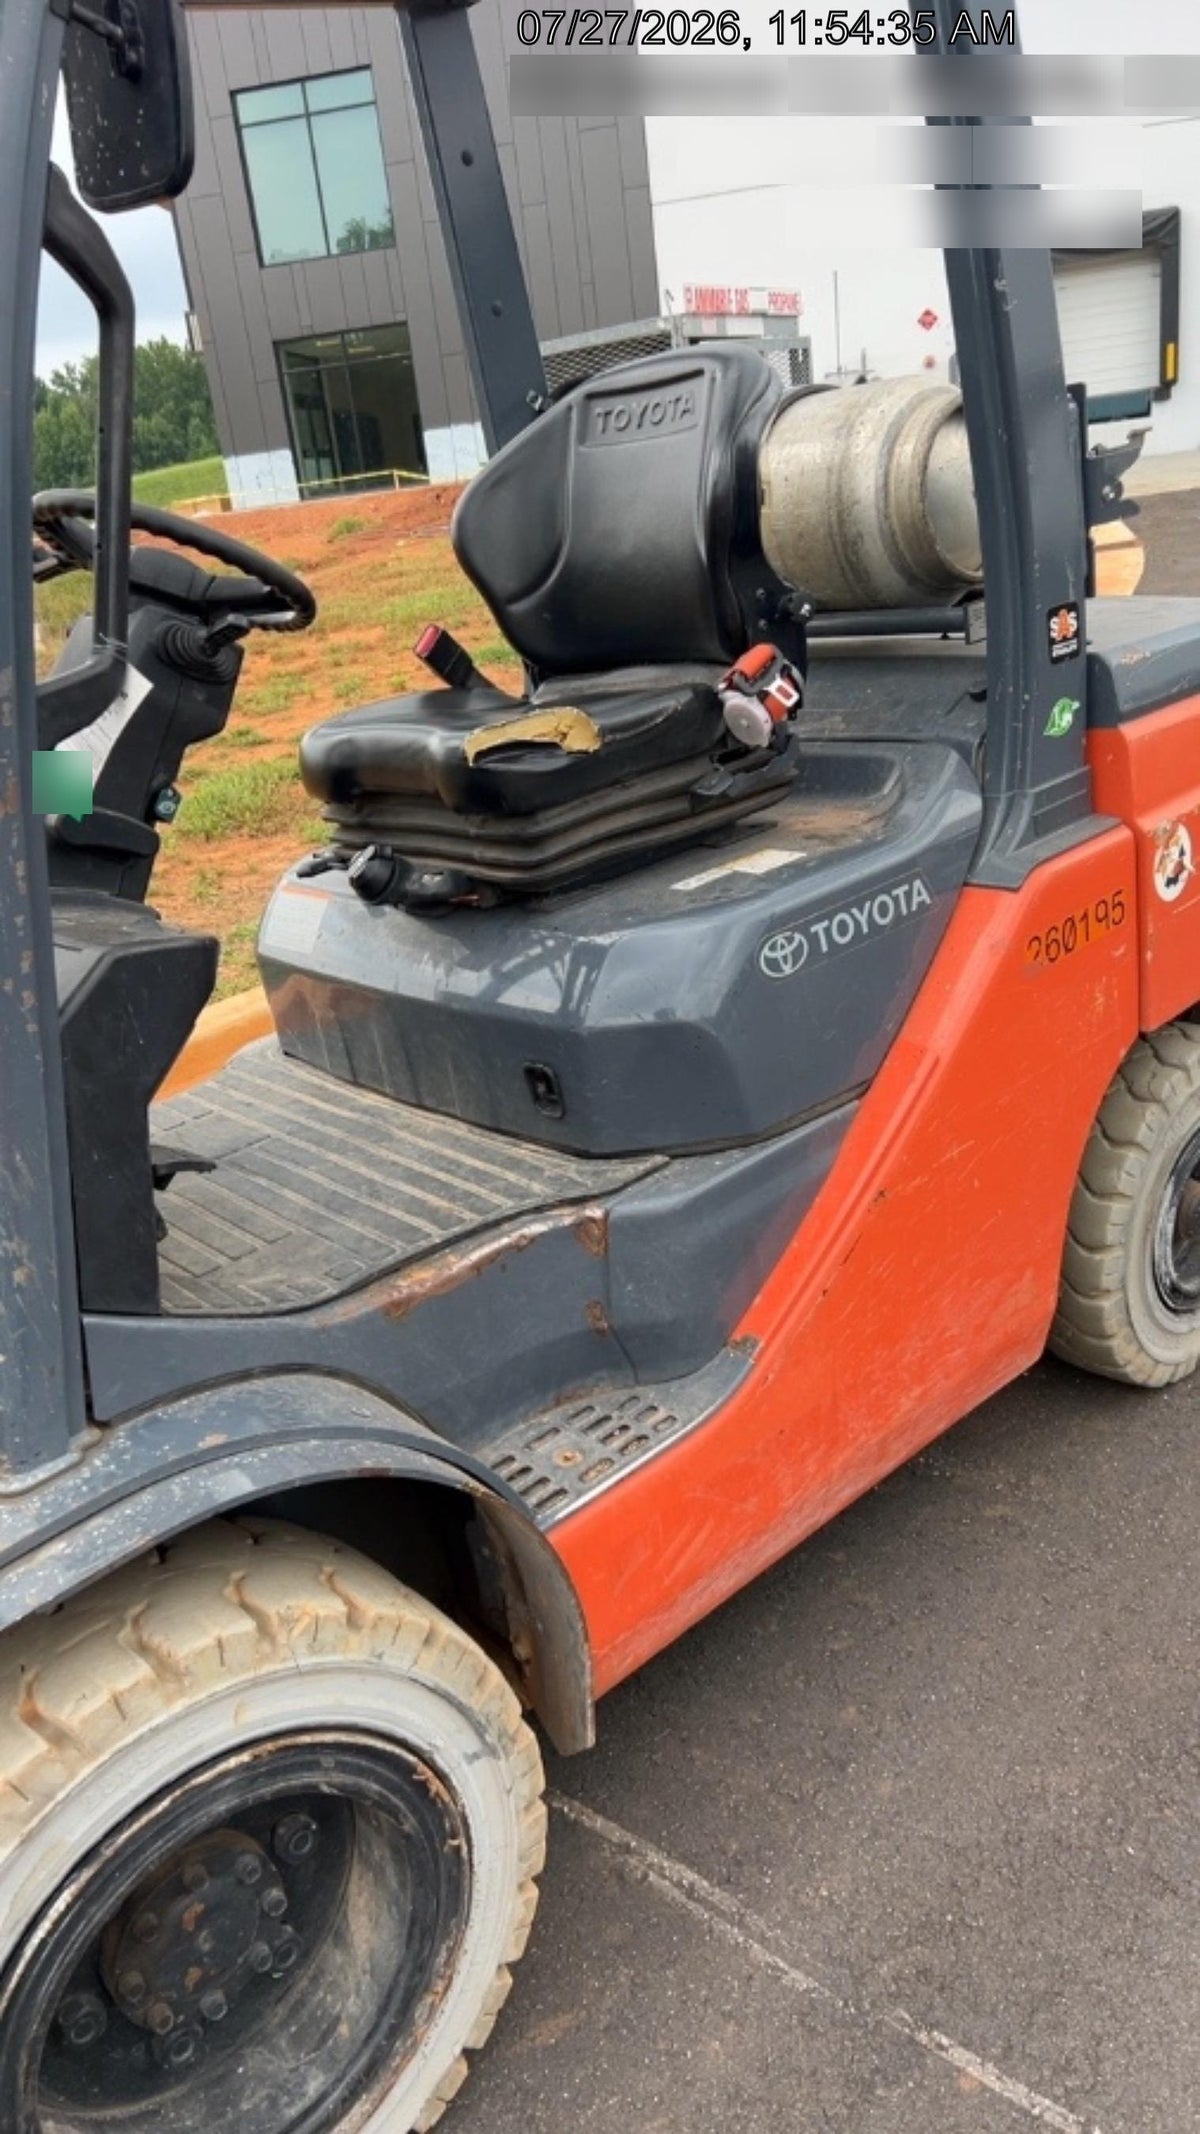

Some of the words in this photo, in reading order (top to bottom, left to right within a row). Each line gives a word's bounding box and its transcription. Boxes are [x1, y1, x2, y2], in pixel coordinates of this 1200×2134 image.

[596, 393, 696, 435] TOYOTA
[811, 879, 932, 953] TOYOTA
[1027, 889, 1125, 963] 260195
